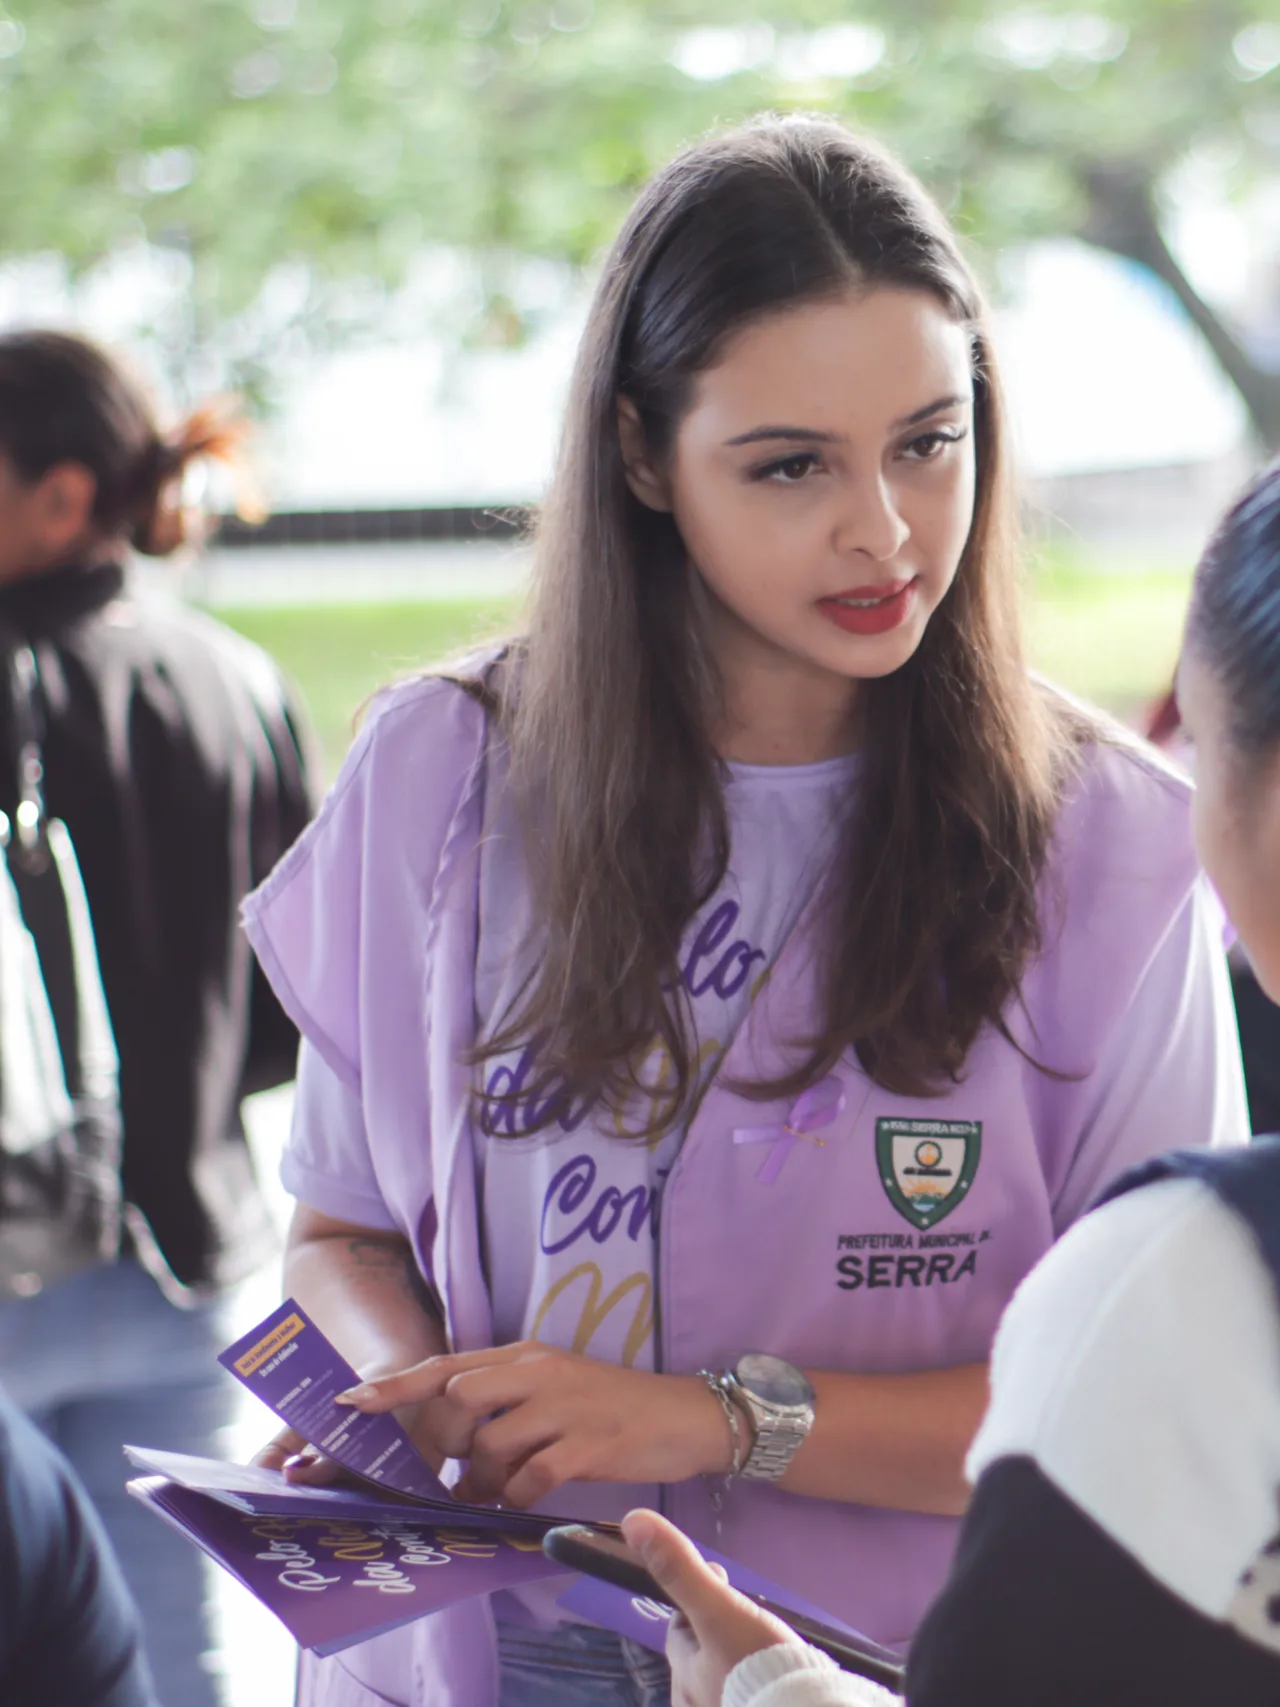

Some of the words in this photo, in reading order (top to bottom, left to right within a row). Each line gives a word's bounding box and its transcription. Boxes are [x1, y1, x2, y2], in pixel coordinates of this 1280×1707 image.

[911, 1121, 949, 1134] SERRA
[836, 1234, 914, 1251] PREFEITURA
[918, 1231, 976, 1250] MUNICIPAL
[835, 1249, 978, 1291] SERRA
[255, 1538, 342, 1592] Pelo
[352, 1560, 417, 1594] da
